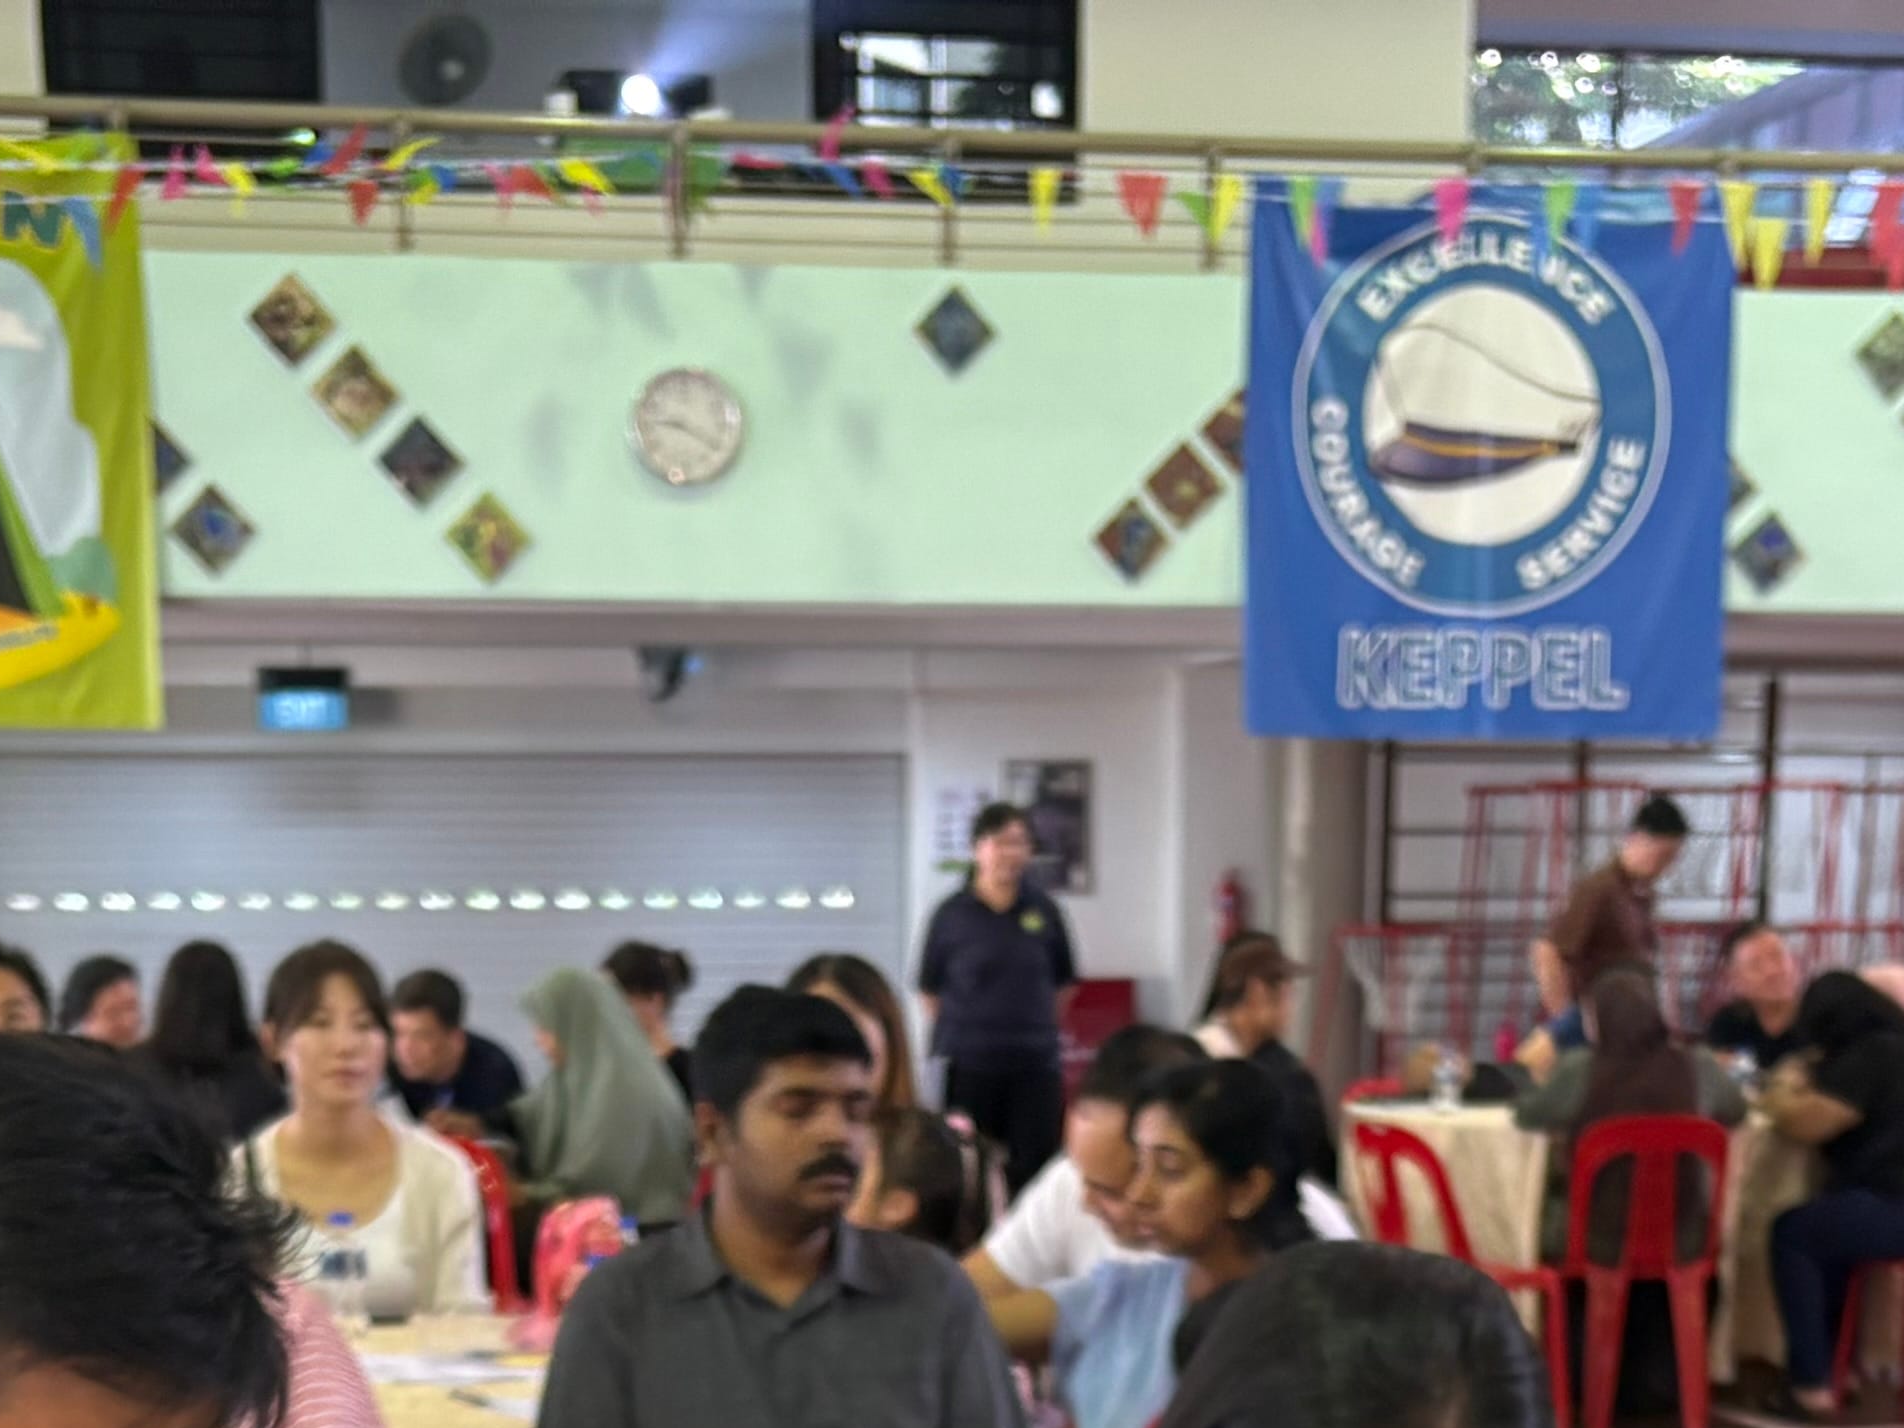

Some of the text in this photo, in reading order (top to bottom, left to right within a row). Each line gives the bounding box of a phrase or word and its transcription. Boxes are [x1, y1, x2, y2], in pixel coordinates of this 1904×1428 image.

[1310, 398, 1427, 589] COURAGE
[1515, 435, 1647, 590] SERVICE
[1335, 620, 1632, 712] KEPPEL
